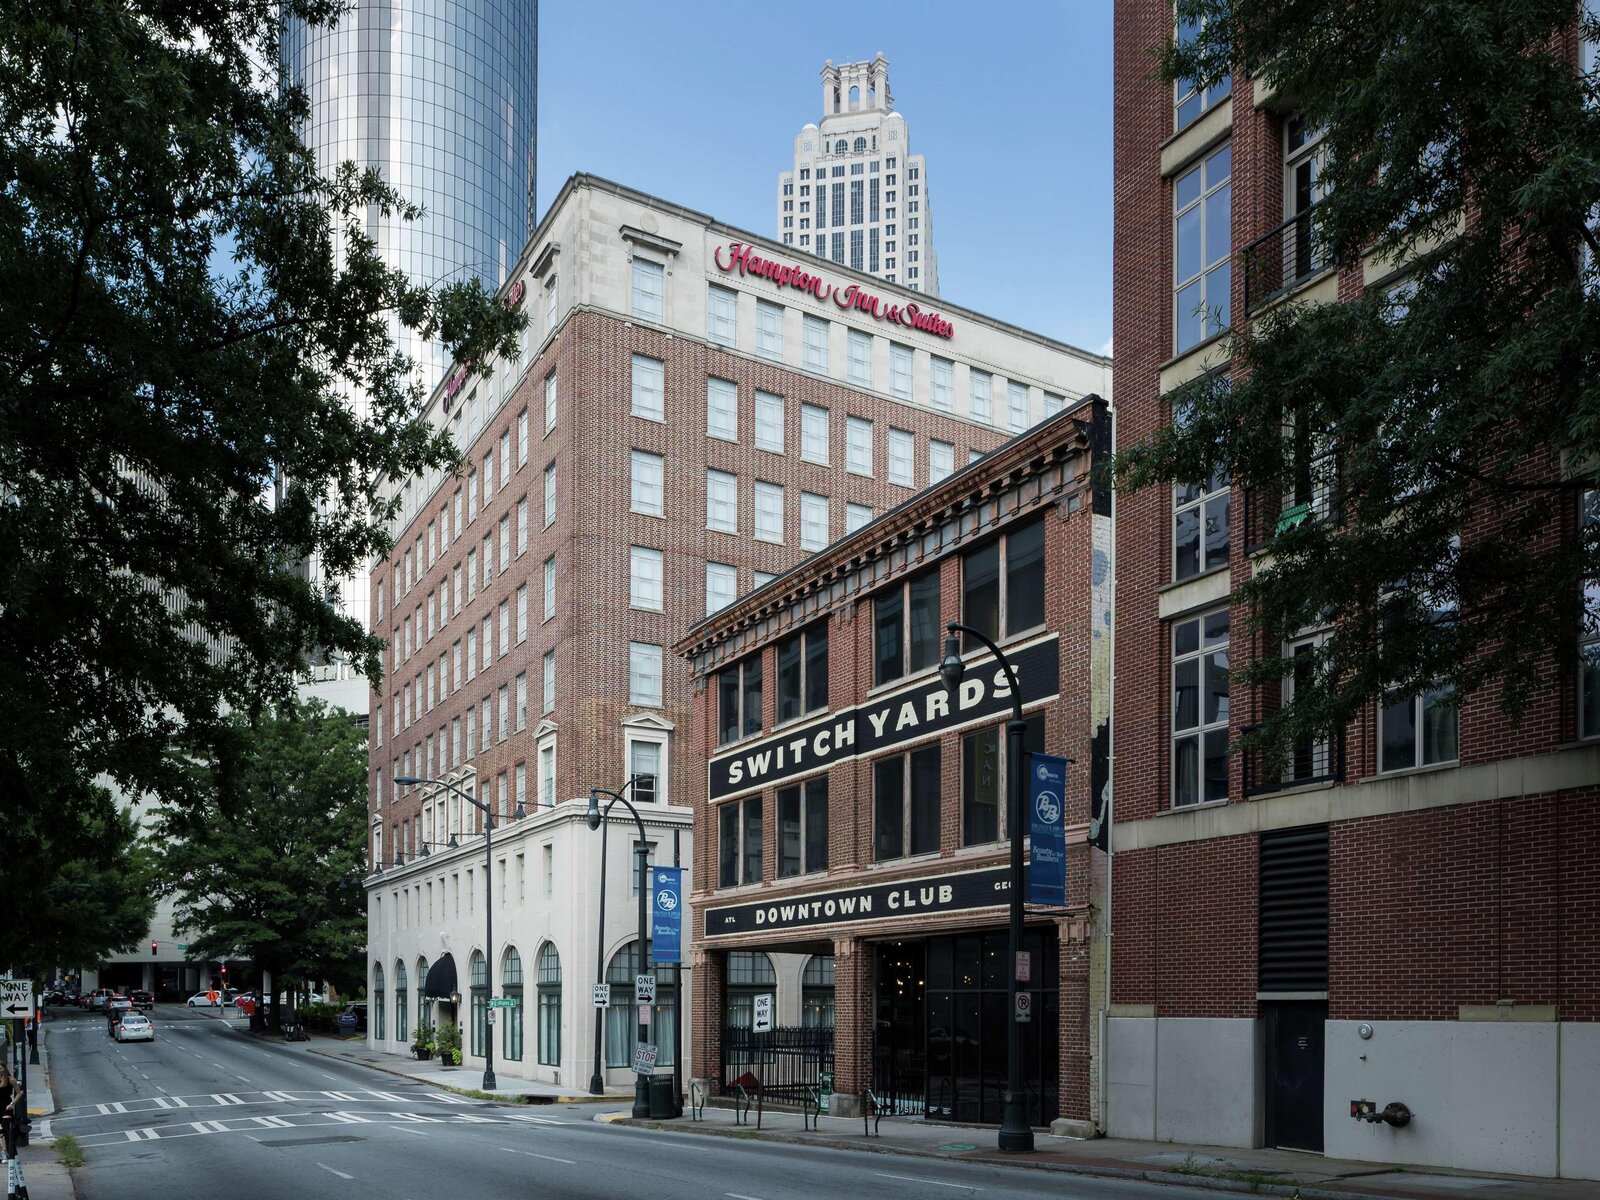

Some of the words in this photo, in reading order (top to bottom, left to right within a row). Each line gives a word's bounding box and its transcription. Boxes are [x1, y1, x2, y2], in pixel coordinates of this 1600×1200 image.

[714, 242, 830, 300] Hampton
[833, 284, 888, 319] Inn
[898, 302, 954, 340] Suites
[755, 894, 872, 926] DOWNTOWN
[888, 884, 954, 909] CLUB
[6, 982, 28, 991] ONE
[5, 993, 28, 1001] WAY
[757, 998, 768, 1007] ONE
[756, 1009, 768, 1018] WAY
[636, 1050, 656, 1062] STOP
